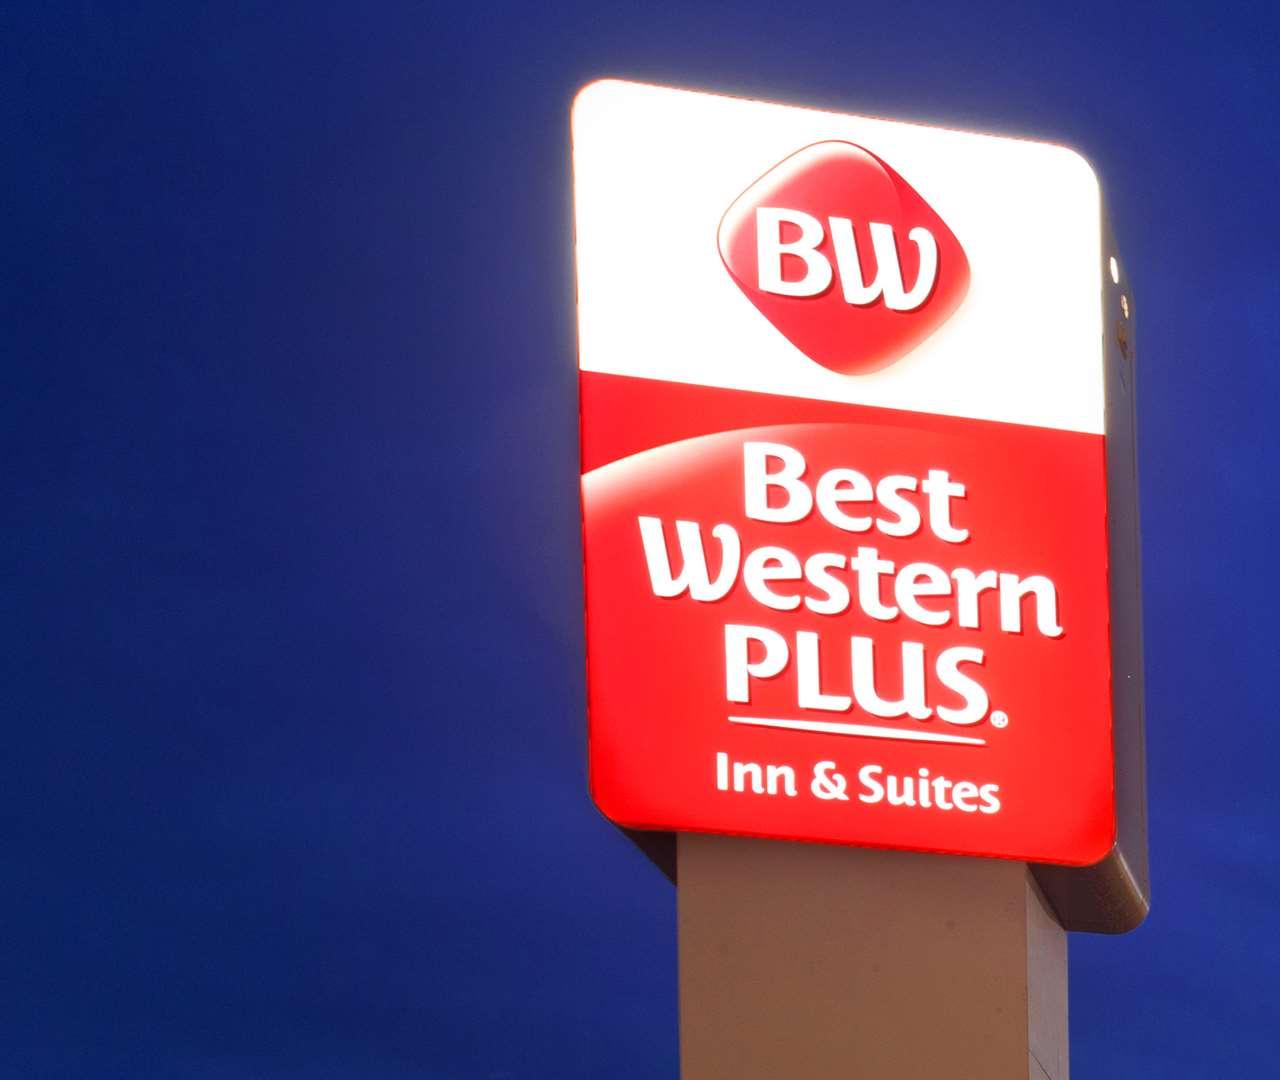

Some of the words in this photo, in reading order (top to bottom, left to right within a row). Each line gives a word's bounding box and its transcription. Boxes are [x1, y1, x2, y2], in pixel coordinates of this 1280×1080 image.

[755, 206, 939, 312] BW
[741, 440, 970, 544] Best
[638, 515, 1064, 637] Western
[716, 751, 798, 798] Inn
[810, 760, 850, 801] &
[858, 765, 1001, 815] Suites
